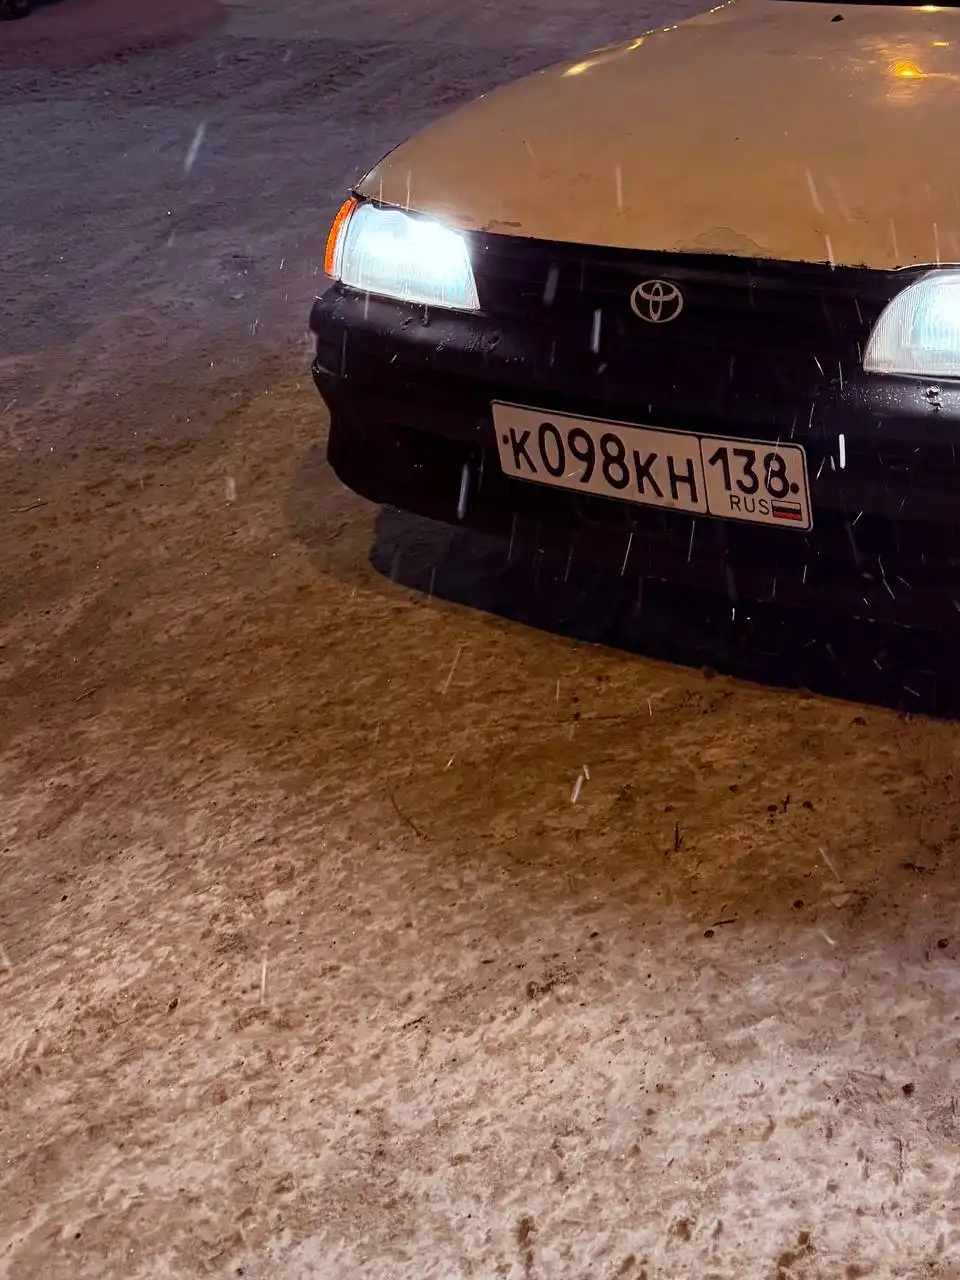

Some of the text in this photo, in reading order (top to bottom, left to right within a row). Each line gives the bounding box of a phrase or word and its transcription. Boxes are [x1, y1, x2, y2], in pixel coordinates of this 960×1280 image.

[508, 422, 790, 503] К098КН 138
[728, 494, 770, 515] RUS
